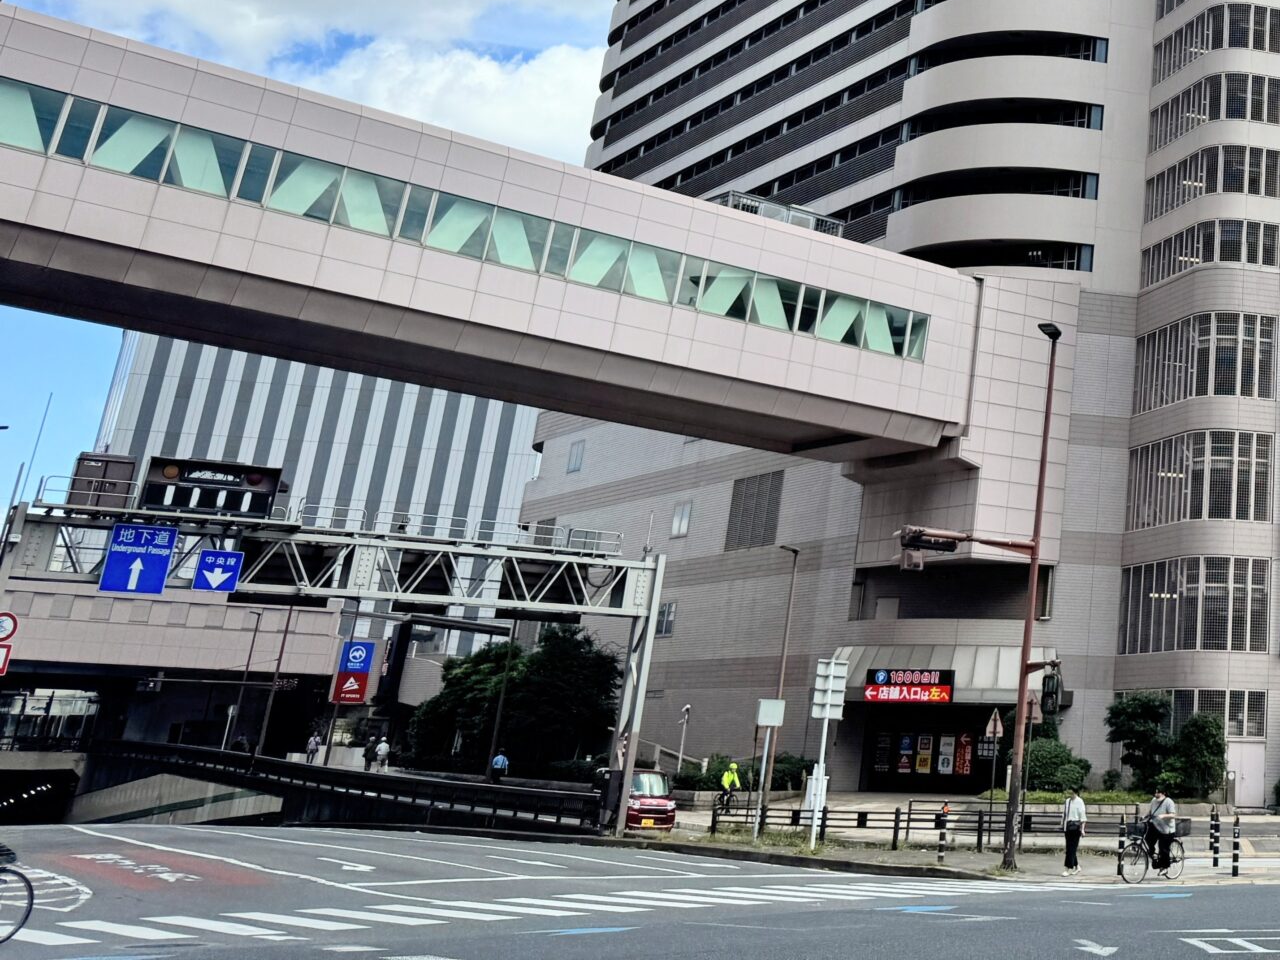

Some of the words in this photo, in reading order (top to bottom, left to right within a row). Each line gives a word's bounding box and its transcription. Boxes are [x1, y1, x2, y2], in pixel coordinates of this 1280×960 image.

[118, 528, 171, 545] 地下道
[111, 543, 146, 554] Underground
[147, 546, 171, 556] Passage
[205, 556, 237, 565] 中央線
